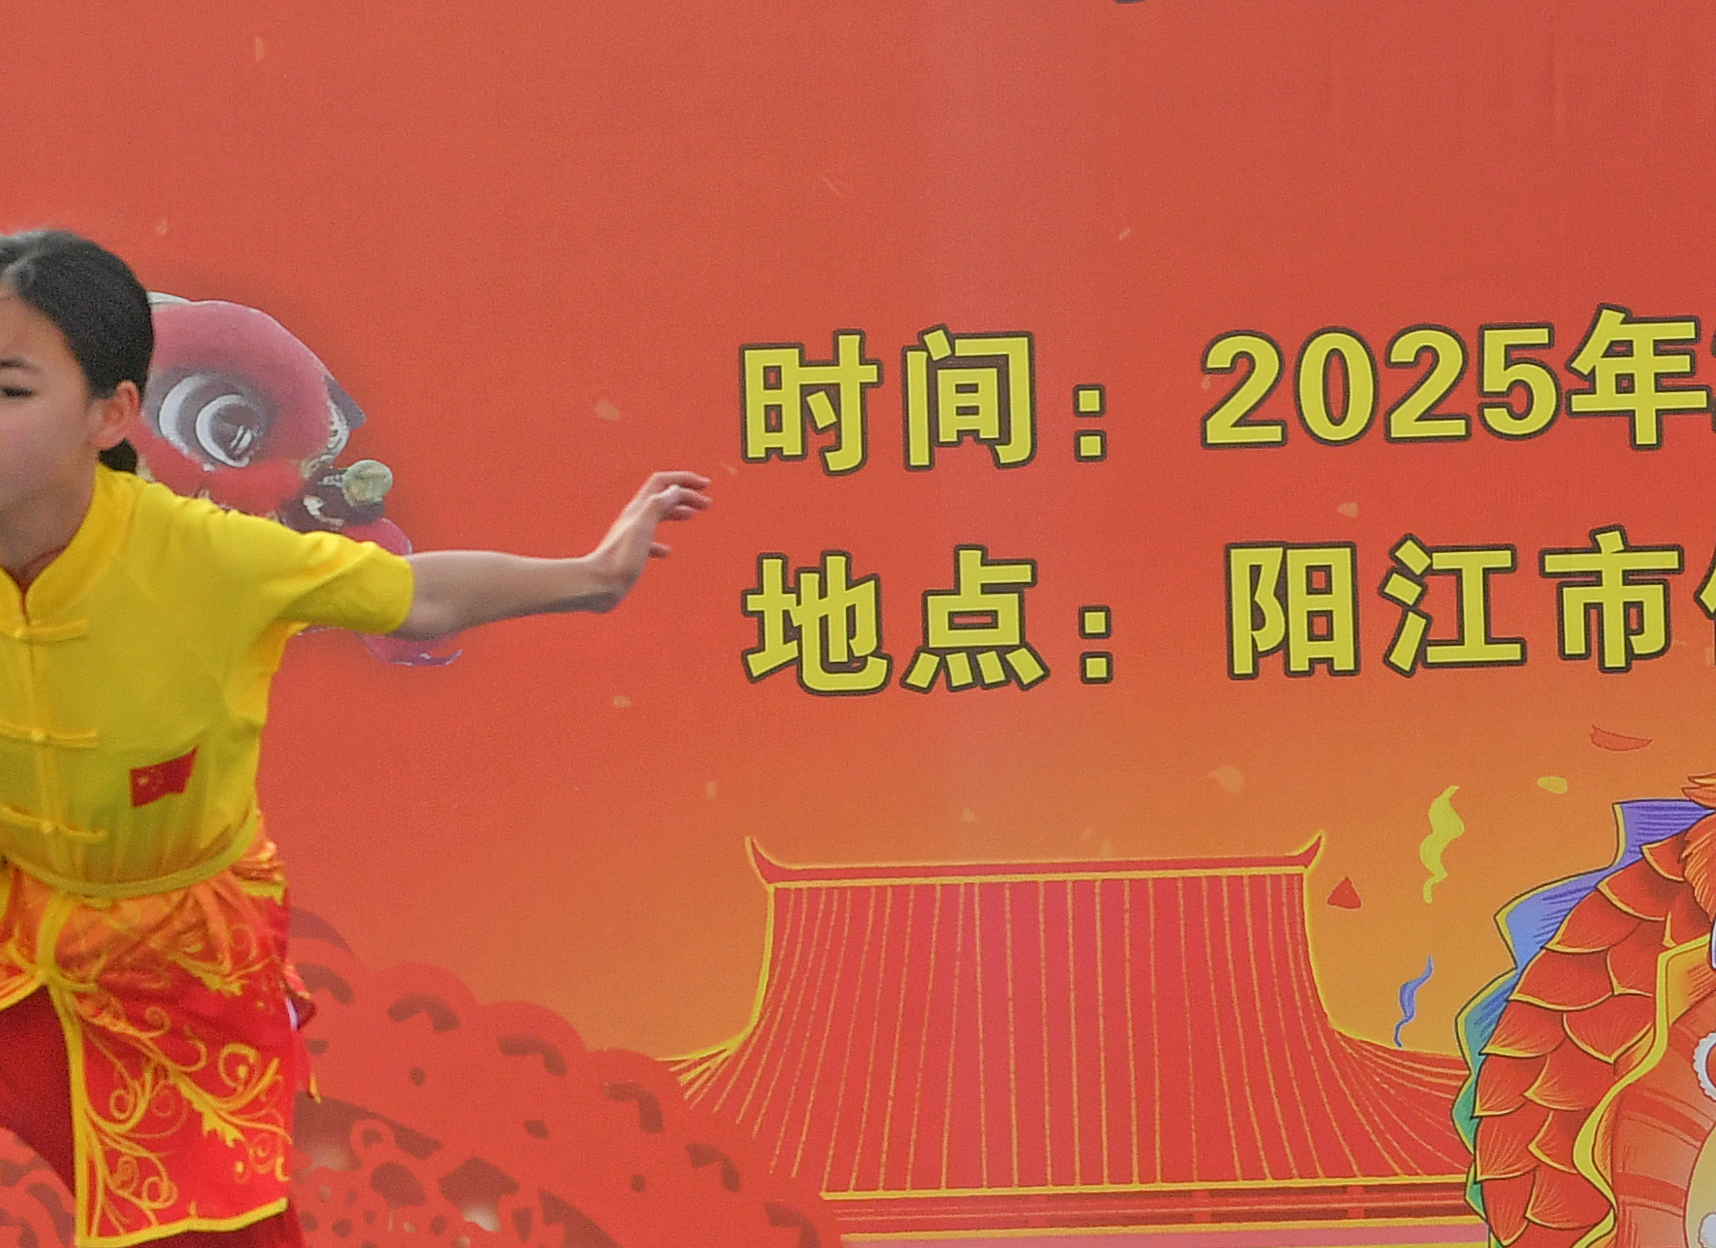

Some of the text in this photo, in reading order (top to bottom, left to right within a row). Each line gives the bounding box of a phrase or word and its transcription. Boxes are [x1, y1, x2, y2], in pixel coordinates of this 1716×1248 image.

[739, 325, 1107, 475] 时间：
[741, 526, 1716, 695] 地点： 阳江市
